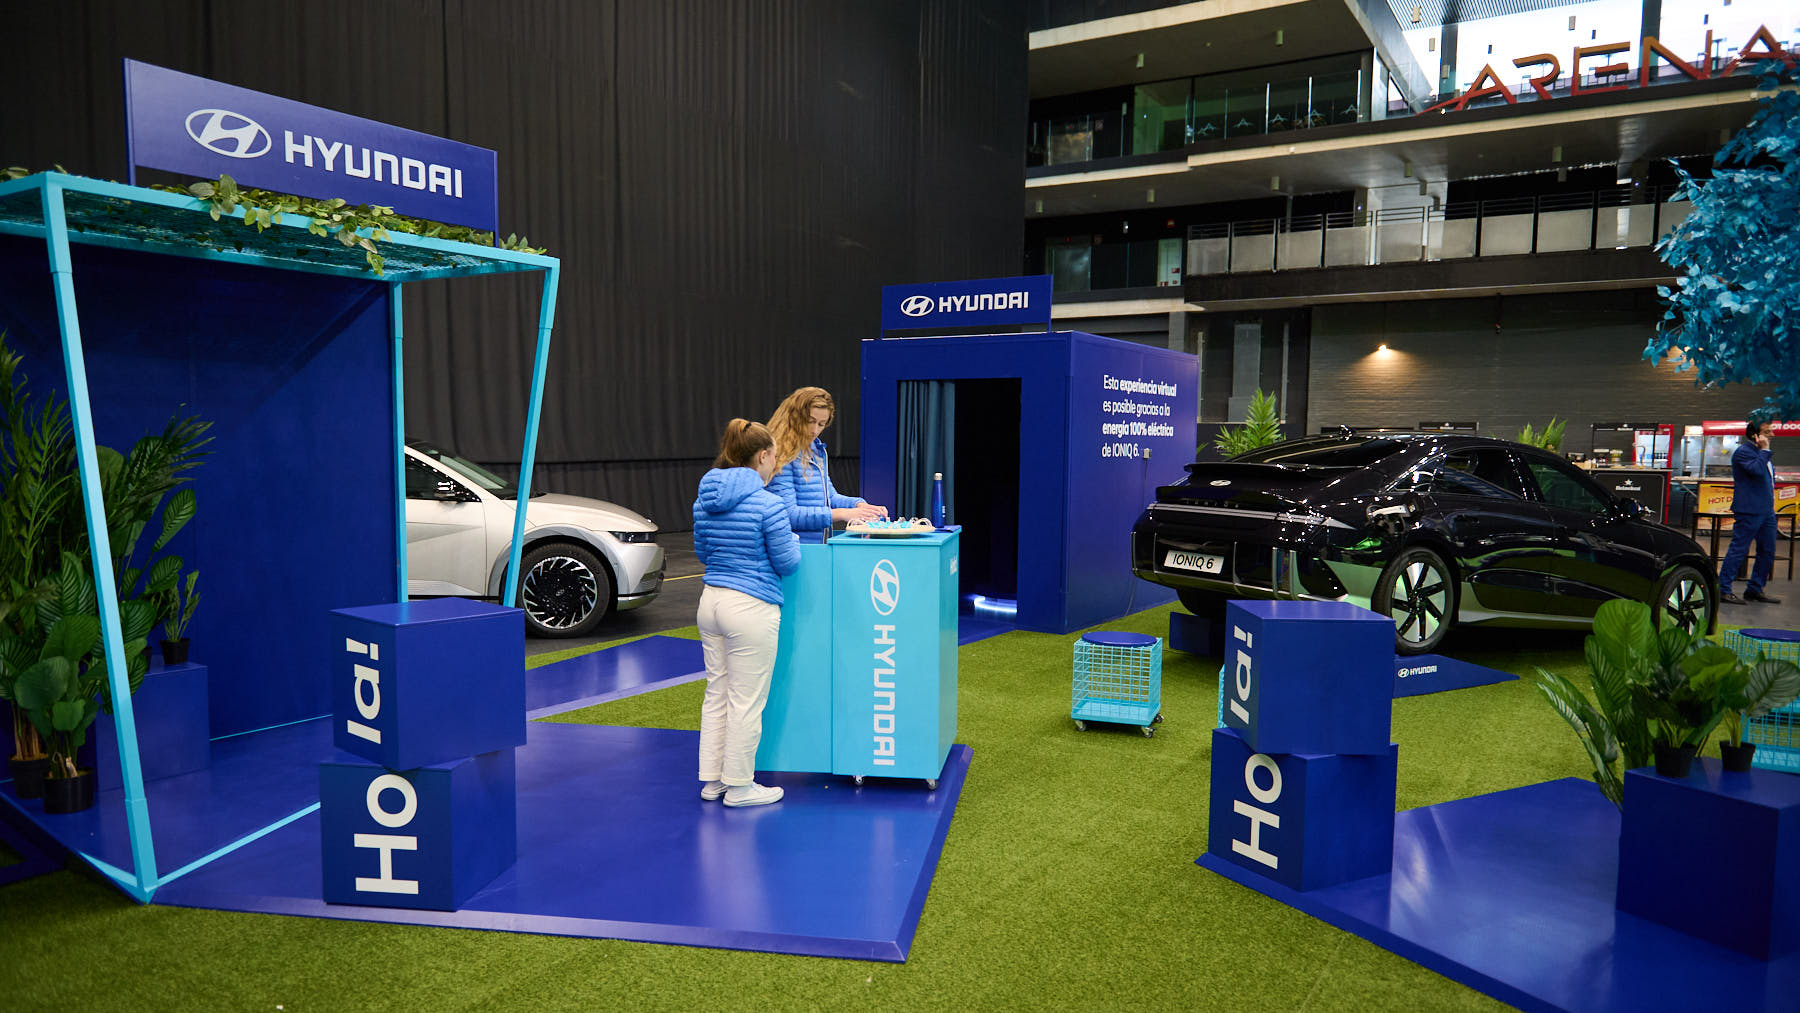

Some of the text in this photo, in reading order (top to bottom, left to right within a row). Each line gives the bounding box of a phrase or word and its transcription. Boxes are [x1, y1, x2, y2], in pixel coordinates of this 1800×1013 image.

[1415, 24, 1798, 113] ARENA
[284, 130, 463, 199] HYUNDAI
[938, 292, 1029, 313] HYUNDAI
[1103, 375, 1177, 396] Esta experiencia virtual
[1103, 399, 1170, 417] es posible gracias a la
[1102, 420, 1174, 438] energía 100% eléctrica
[1102, 443, 1139, 459] de IONIQ 6.
[1173, 554, 1214, 570] IONIQ 6
[1410, 665, 1437, 675] HYUNDAI
[873, 624, 896, 766] HYUNDAI
[1232, 753, 1282, 870] Ho
[353, 773, 419, 895] Ho
